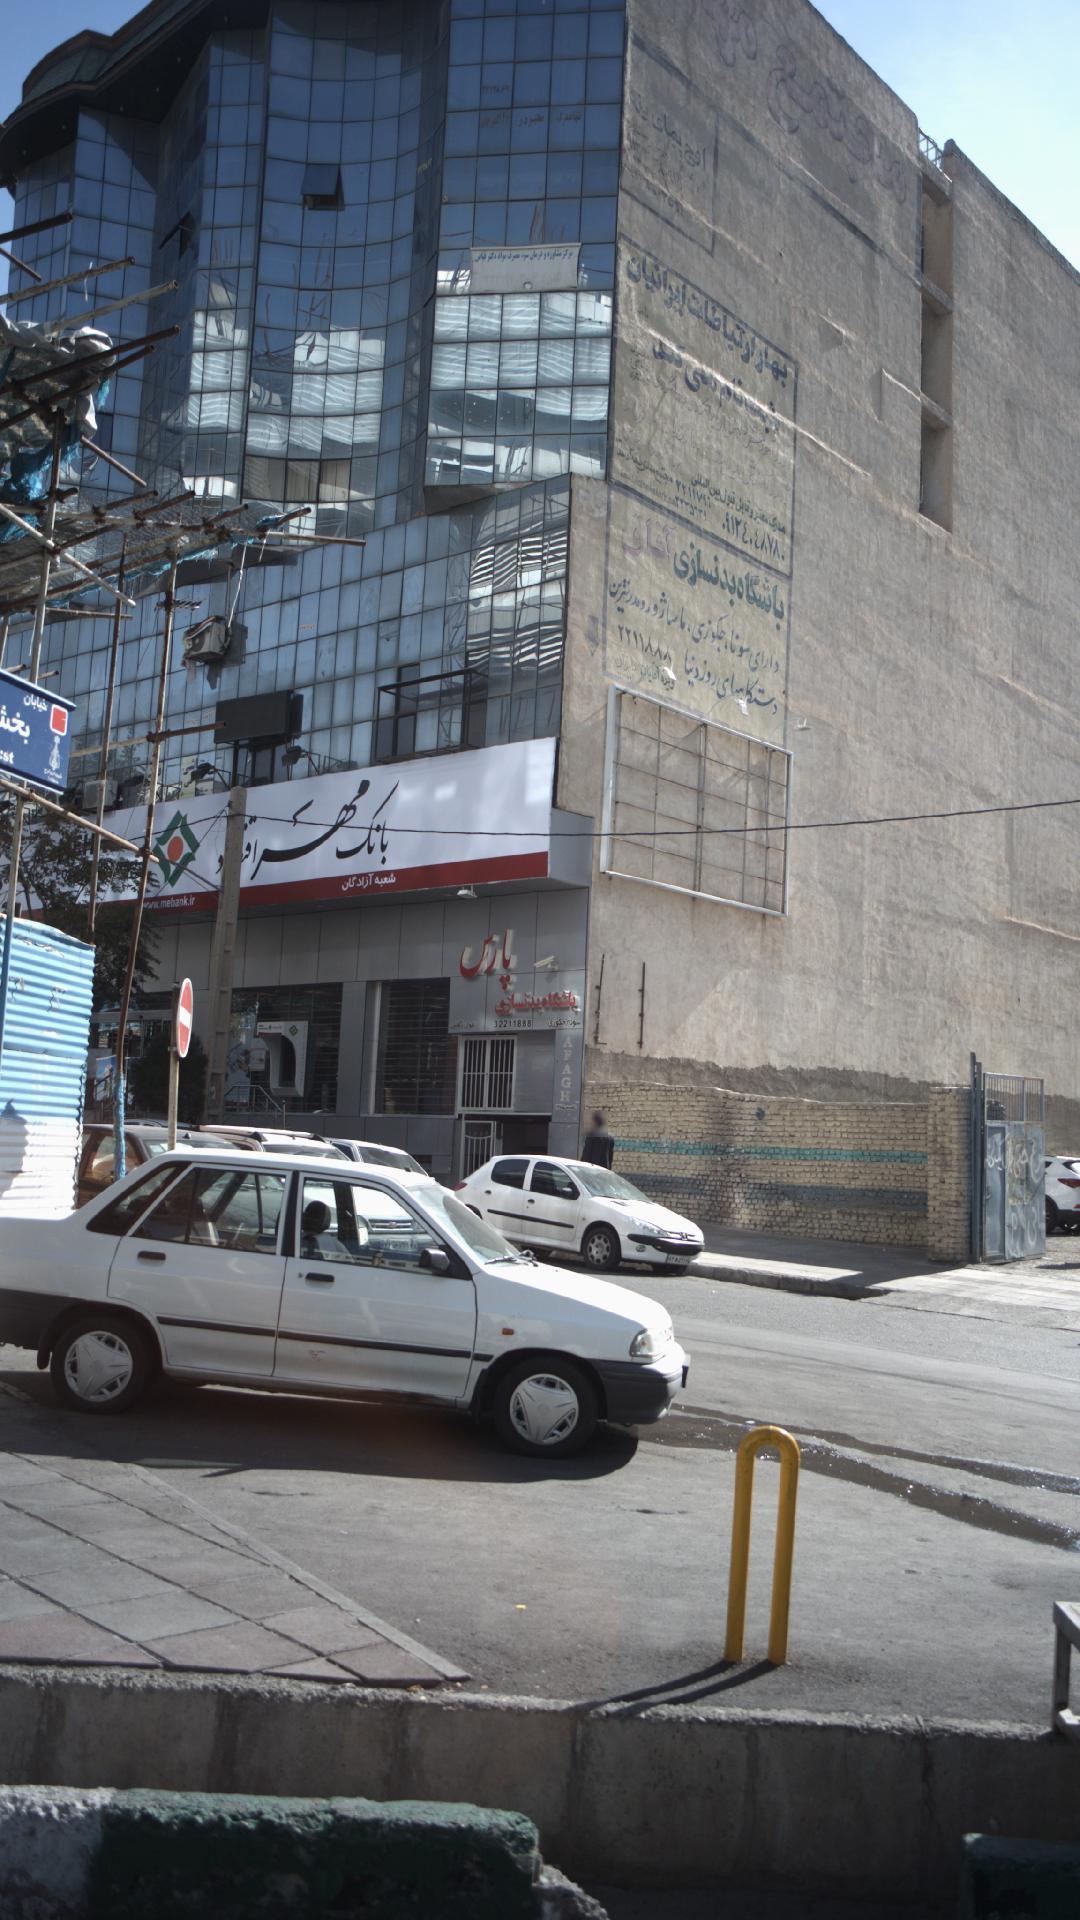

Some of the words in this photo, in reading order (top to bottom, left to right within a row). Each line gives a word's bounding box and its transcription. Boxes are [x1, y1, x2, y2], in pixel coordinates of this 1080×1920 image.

[687, 293, 756, 363] ارتباطات
[756, 344, 788, 388] بهار
[737, 573, 785, 630] باشگاه
[684, 648, 700, 687] دنیا
[700, 659, 718, 686] روز
[749, 651, 780, 673] دارای
[23, 693, 48, 712] خیابان
[250, 779, 371, 881] مهر
[336, 779, 400, 865] بانک
[341, 872, 374, 892] آزادگان
[374, 872, 396, 885] شعبه
[559, 1036, 573, 1103] AFAGH
